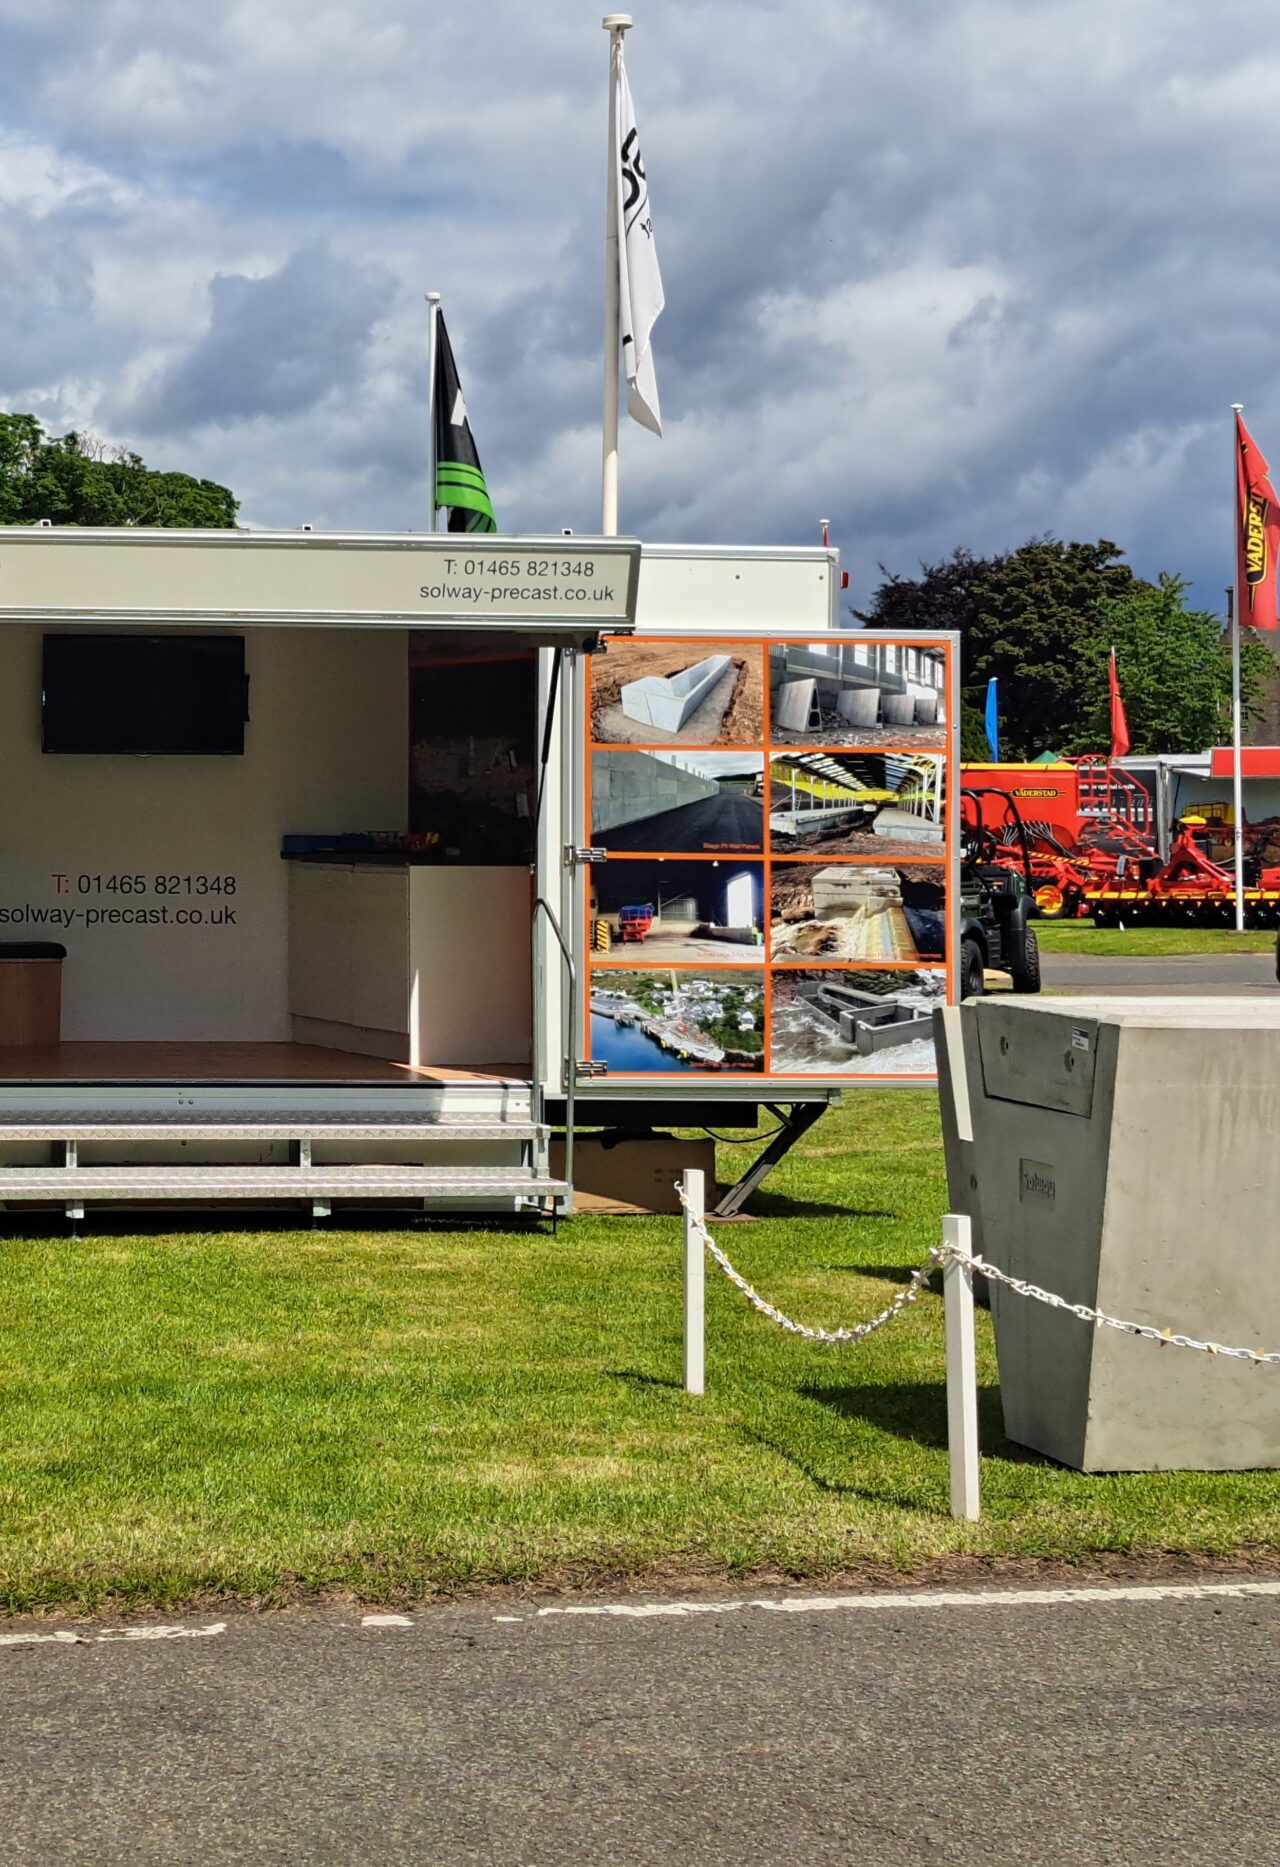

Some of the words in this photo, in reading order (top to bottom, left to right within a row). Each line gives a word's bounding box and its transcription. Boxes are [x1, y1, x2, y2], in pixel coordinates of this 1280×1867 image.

[444, 559, 457, 575] T:
[464, 559, 520, 576] 01465
[526, 561, 595, 577] 821348
[420, 583, 615, 603] solway-precast.co.uk
[52, 874, 69, 893] T:
[78, 874, 146, 894] 01465
[154, 875, 237, 895] 821348
